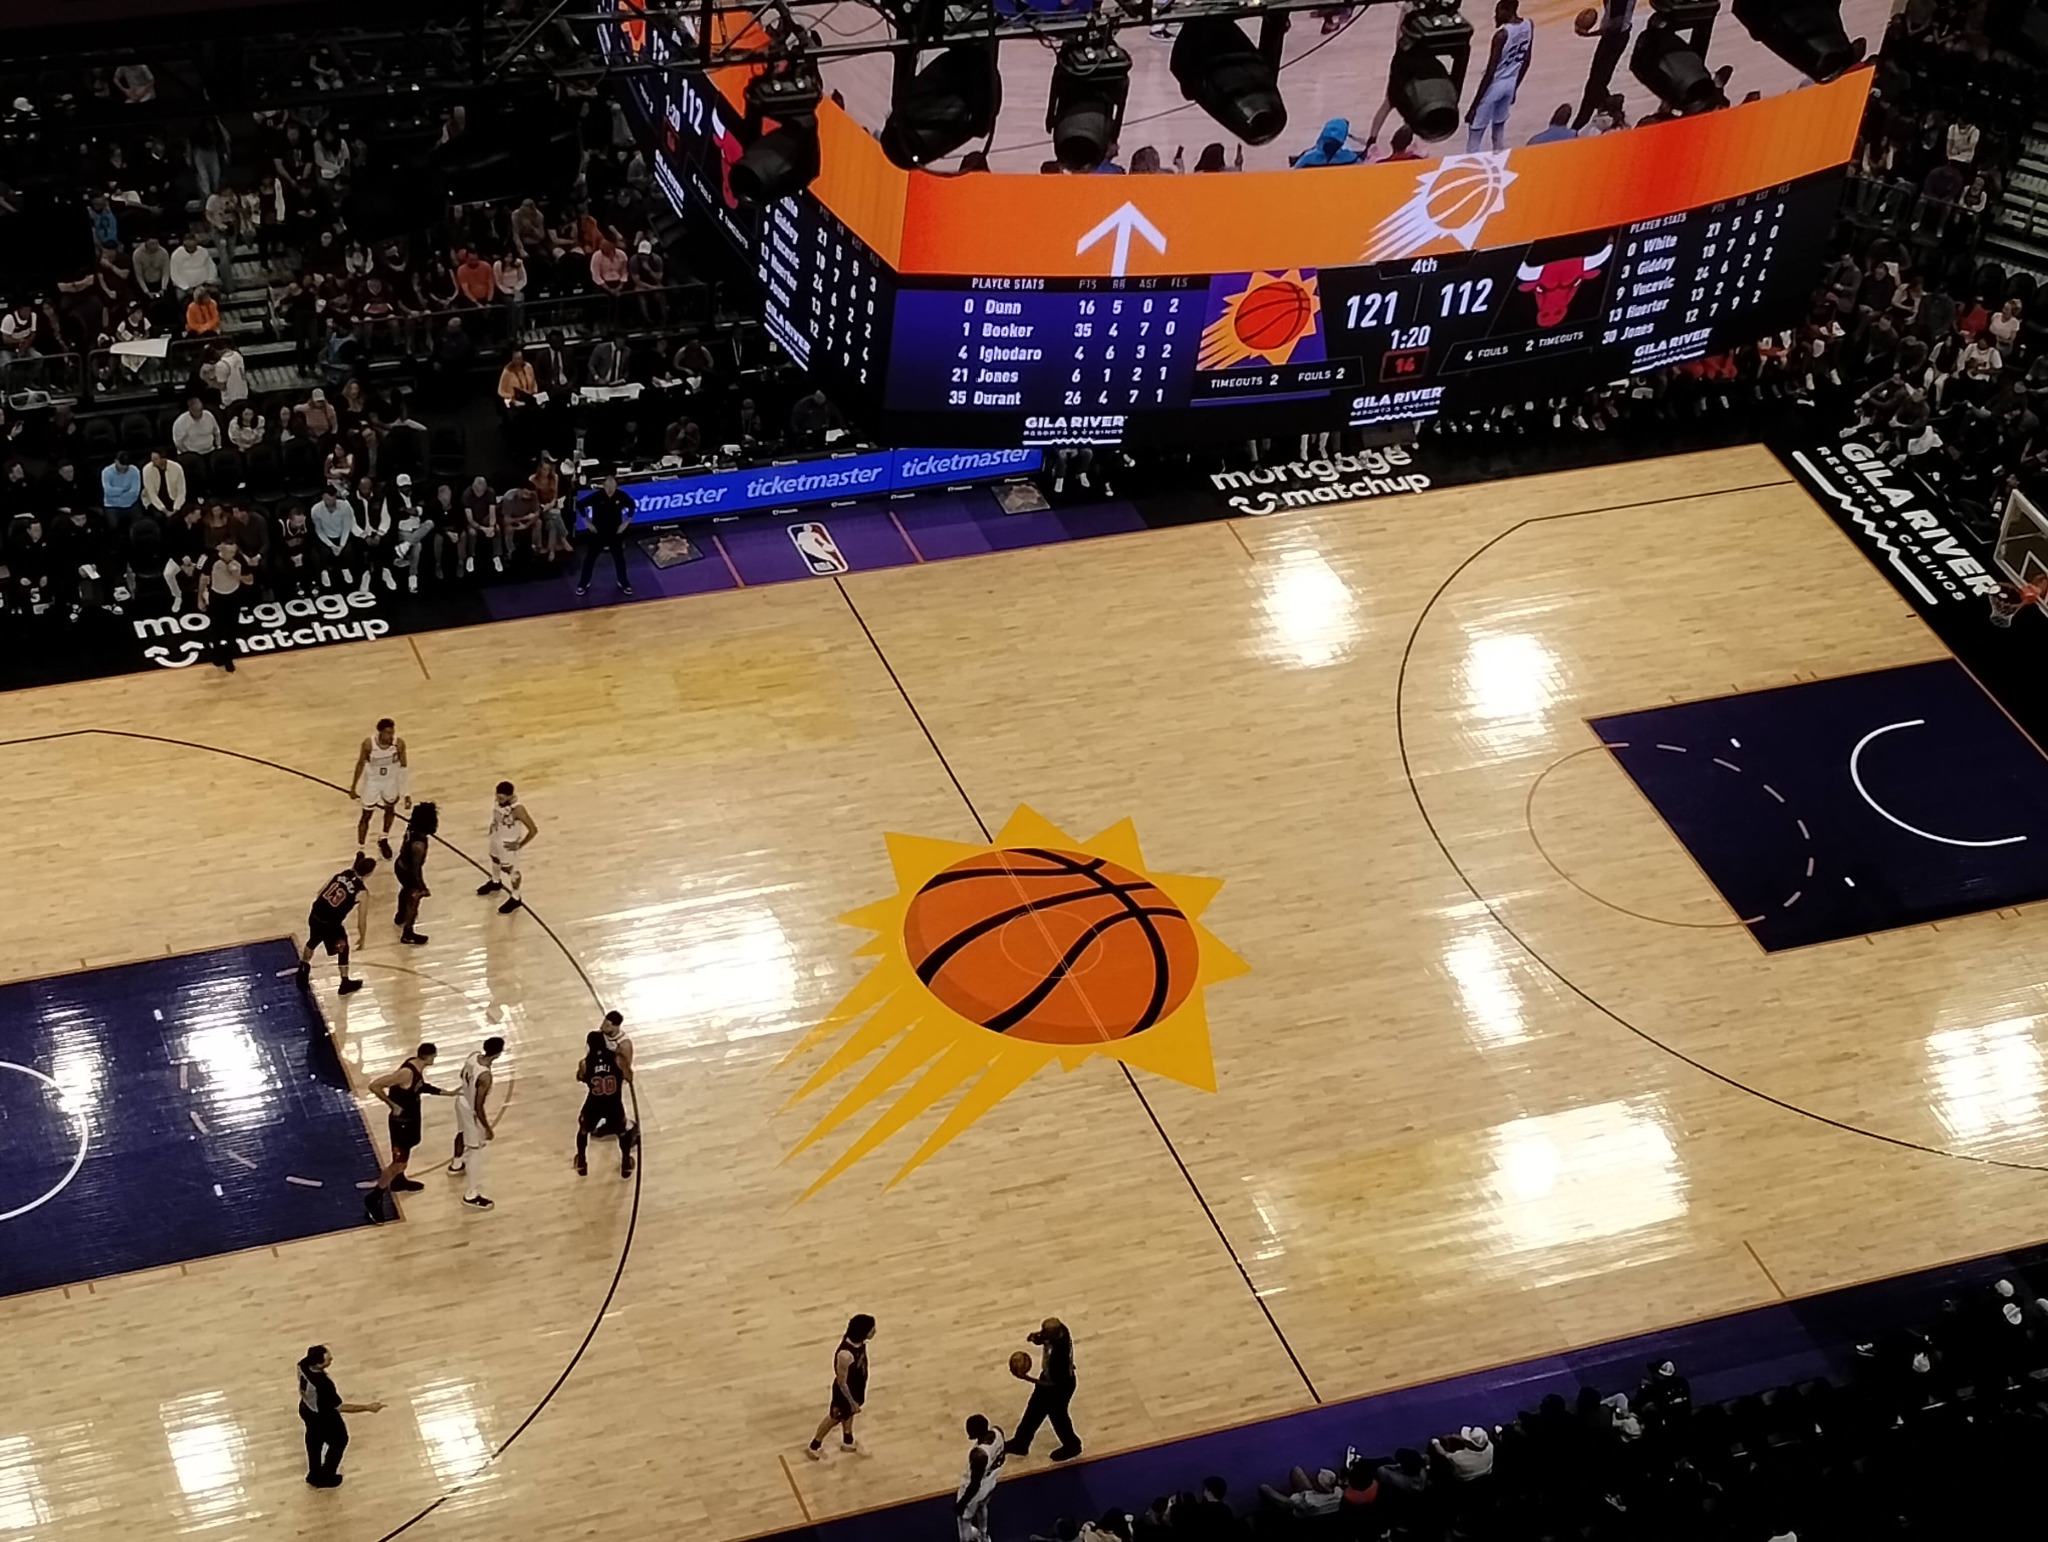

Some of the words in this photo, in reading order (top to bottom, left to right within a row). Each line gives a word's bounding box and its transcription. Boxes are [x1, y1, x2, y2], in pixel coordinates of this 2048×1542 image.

[682, 79, 703, 136] 112
[1627, 242, 1637, 257] 0
[1643, 234, 1678, 254] White
[1731, 216, 1742, 231] 5
[1754, 209, 1763, 224] 5
[1775, 203, 1785, 218] 3
[817, 227, 827, 247] 21
[869, 276, 877, 292] 3
[1411, 257, 1438, 274] 4th
[1621, 265, 1631, 279] 3
[1702, 243, 1716, 259] 18
[1727, 238, 1736, 253] 7
[1769, 225, 1779, 239] 0
[816, 251, 826, 270] 18
[833, 267, 840, 283] 7
[867, 300, 874, 315] 0
[971, 278, 1010, 289] PLAYER
[1014, 278, 1045, 290] STATS
[1079, 279, 1097, 290] PTS
[1139, 277, 1158, 288] AST
[1171, 277, 1188, 288] FLS
[1616, 286, 1626, 301] 9
[1742, 253, 1752, 268] 2
[1763, 247, 1773, 261] 2
[812, 297, 821, 315] 13
[829, 314, 835, 330] 2
[964, 299, 974, 314] 0
[984, 299, 1022, 315] Dunn
[1079, 300, 1095, 315] 16
[1112, 299, 1122, 314] 5
[1143, 299, 1153, 313] 0
[1169, 298, 1179, 313] 2
[1346, 291, 1399, 329] 121
[1440, 278, 1494, 317] 112
[1602, 329, 1618, 345] 30
[1620, 322, 1655, 341] Jones
[1685, 308, 1699, 324] 12
[1709, 303, 1719, 317] 7
[1731, 296, 1740, 310] 9
[1752, 290, 1761, 304] 2
[1609, 307, 1623, 323] 13
[1691, 287, 1705, 302] 13
[1714, 281, 1724, 296] 2
[848, 307, 854, 323] 2
[864, 323, 871, 338] 2
[962, 322, 970, 337] 1
[982, 323, 1034, 338] Booker
[1074, 323, 1092, 338] 35
[1108, 322, 1118, 337] 4
[1140, 322, 1150, 336] 7
[1165, 321, 1176, 336] 0
[1391, 324, 1431, 350] 1:20
[810, 319, 819, 338] 12
[827, 336, 833, 351] 7
[860, 368, 867, 384] 2
[958, 345, 968, 360] 4
[979, 345, 1042, 363] Ighodaro
[1074, 345, 1084, 360] 4
[1106, 345, 1115, 360] 6
[1136, 345, 1146, 359] 3
[1162, 344, 1172, 359] 2
[1478, 345, 1509, 358] FOULS
[1525, 340, 1535, 352] 2
[1538, 331, 1584, 347] TIMEOUTS
[1634, 340, 1667, 357] GILA
[1669, 327, 1713, 348] RIVER
[951, 368, 968, 383] 21
[975, 368, 1019, 384] Jones
[1071, 368, 1081, 383] 6
[1103, 368, 1111, 383] 1
[1131, 367, 1142, 382] 2
[1159, 366, 1167, 381] 1
[1211, 376, 1263, 389] TIMEOUTS
[1270, 374, 1279, 386] 2
[1298, 370, 1331, 382] FOULS
[1336, 367, 1346, 380] 2
[949, 390, 966, 405] 35
[973, 390, 1021, 406] Durant
[1064, 391, 1082, 405] 26
[1098, 390, 1108, 404] 4
[1129, 389, 1139, 404] 7
[1155, 388, 1163, 403] 1
[1352, 394, 1391, 409] GILA
[1393, 386, 1442, 404] RIVER
[1025, 416, 1067, 429] GILA
[1070, 415, 1125, 428] RIVER
[747, 467, 883, 498] ticketmaster
[901, 448, 1030, 478] ticketmaster
[1210, 445, 1412, 490] mortgage
[1282, 474, 1431, 507] matchup
[1817, 446, 1885, 514] RESORTS
[1899, 534, 1966, 601] CASINOS
[1842, 442, 1915, 508] GILA
[1901, 509, 1998, 597] RIVER
[133, 590, 377, 639] motgage
[591, 1075, 617, 1096] 30
